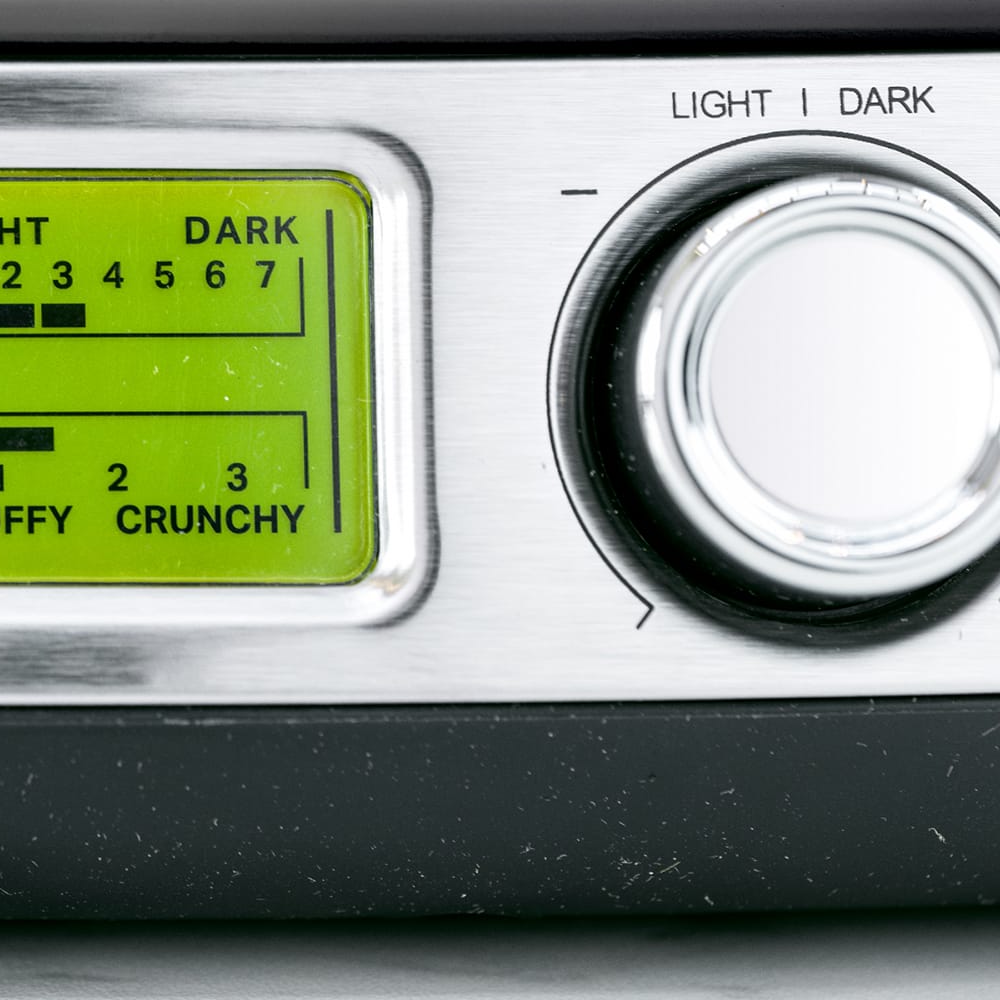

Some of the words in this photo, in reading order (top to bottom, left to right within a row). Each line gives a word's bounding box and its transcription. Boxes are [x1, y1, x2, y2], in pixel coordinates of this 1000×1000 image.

[672, 90, 772, 118] LIGHT
[840, 86, 935, 115] DARK
[185, 216, 298, 244] DARK
[2, 261, 22, 289] 2
[53, 261, 73, 289] 3
[103, 262, 124, 288] 4
[155, 261, 174, 289] 5
[206, 260, 225, 289] 6
[256, 261, 275, 288] 7
[108, 463, 128, 491] 2
[227, 463, 247, 491] 3
[117, 504, 304, 534] CRUNCHY
